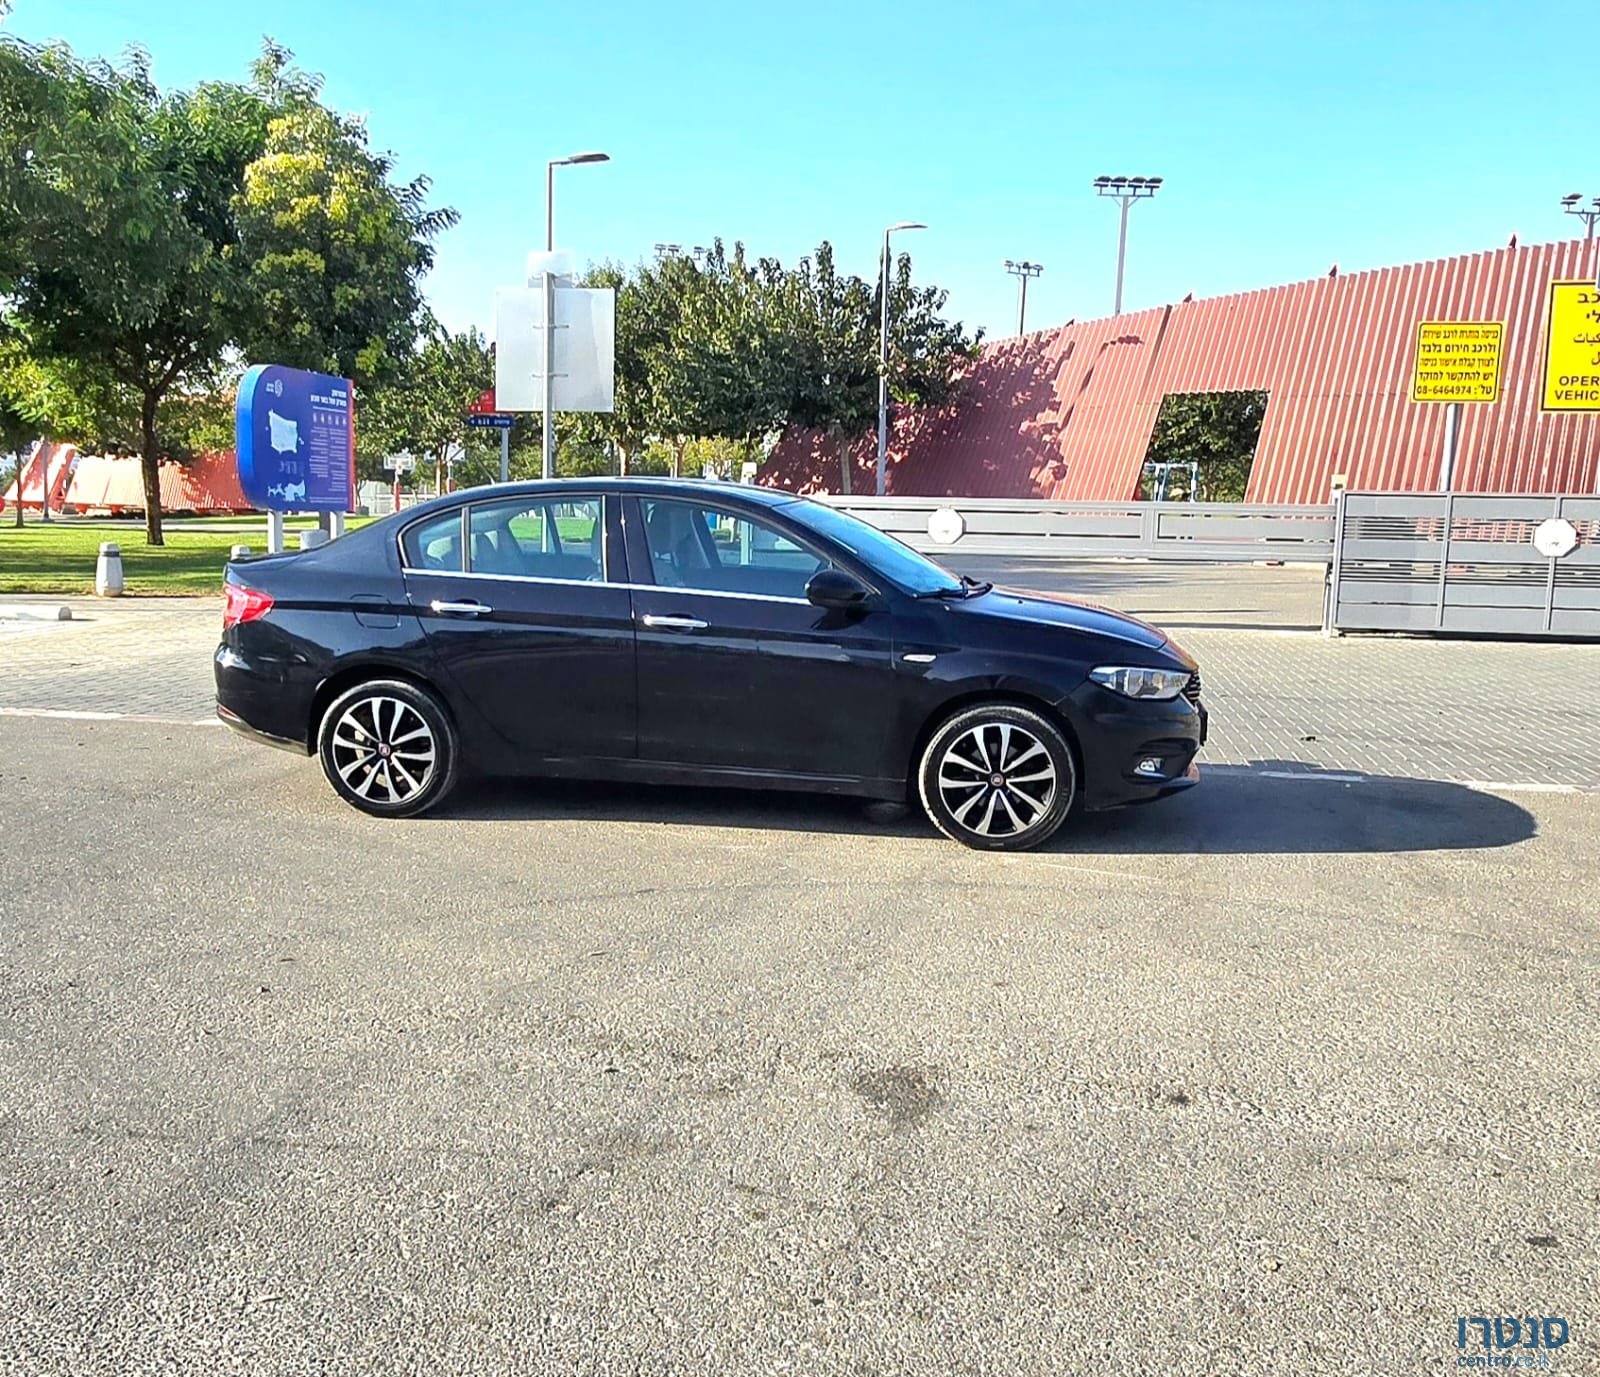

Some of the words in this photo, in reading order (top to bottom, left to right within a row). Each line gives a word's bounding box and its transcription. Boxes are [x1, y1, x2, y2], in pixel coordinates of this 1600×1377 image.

[1443, 329, 1458, 339] לרכב
[1421, 343, 1441, 353] בלבד
[1445, 344, 1469, 353] חירום
[1471, 343, 1496, 353] ולרכב
[1419, 370, 1443, 382] למוקד
[1446, 370, 1480, 382] להתקשר
[1483, 372, 1493, 381] יש
[1559, 375, 1600, 386] OPER
[1416, 385, 1471, 395] 08-6464974
[1555, 390, 1599, 401] VEHIC
